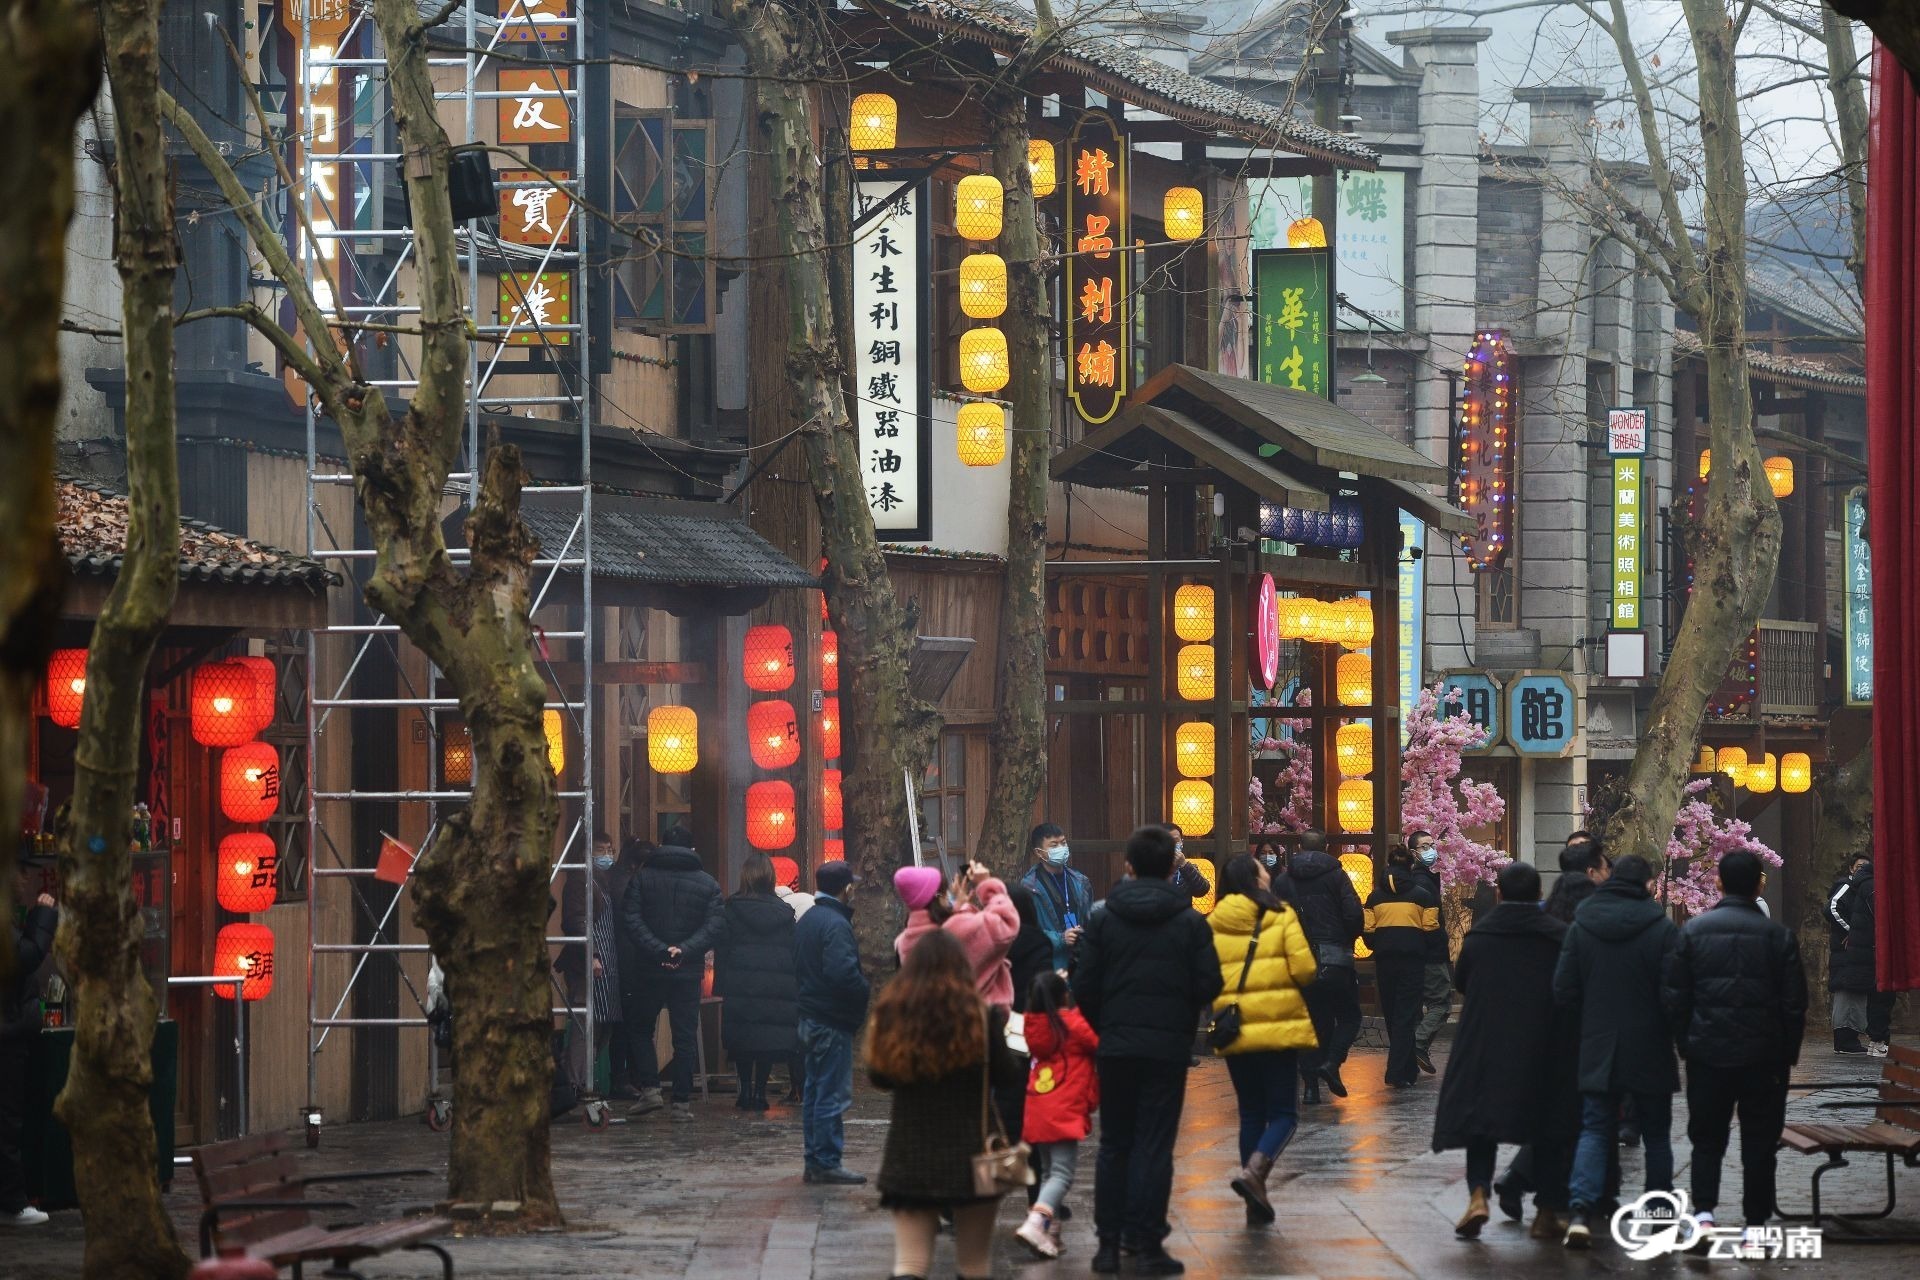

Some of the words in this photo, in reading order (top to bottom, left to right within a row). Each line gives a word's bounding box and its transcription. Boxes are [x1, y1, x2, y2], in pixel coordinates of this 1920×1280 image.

[869, 227, 905, 513] 永生利銅鐵器油漆
[1610, 414, 1645, 430] WONDER
[1614, 434, 1640, 449] BREAD
[1617, 466, 1636, 619] 米蘭美術照相館
